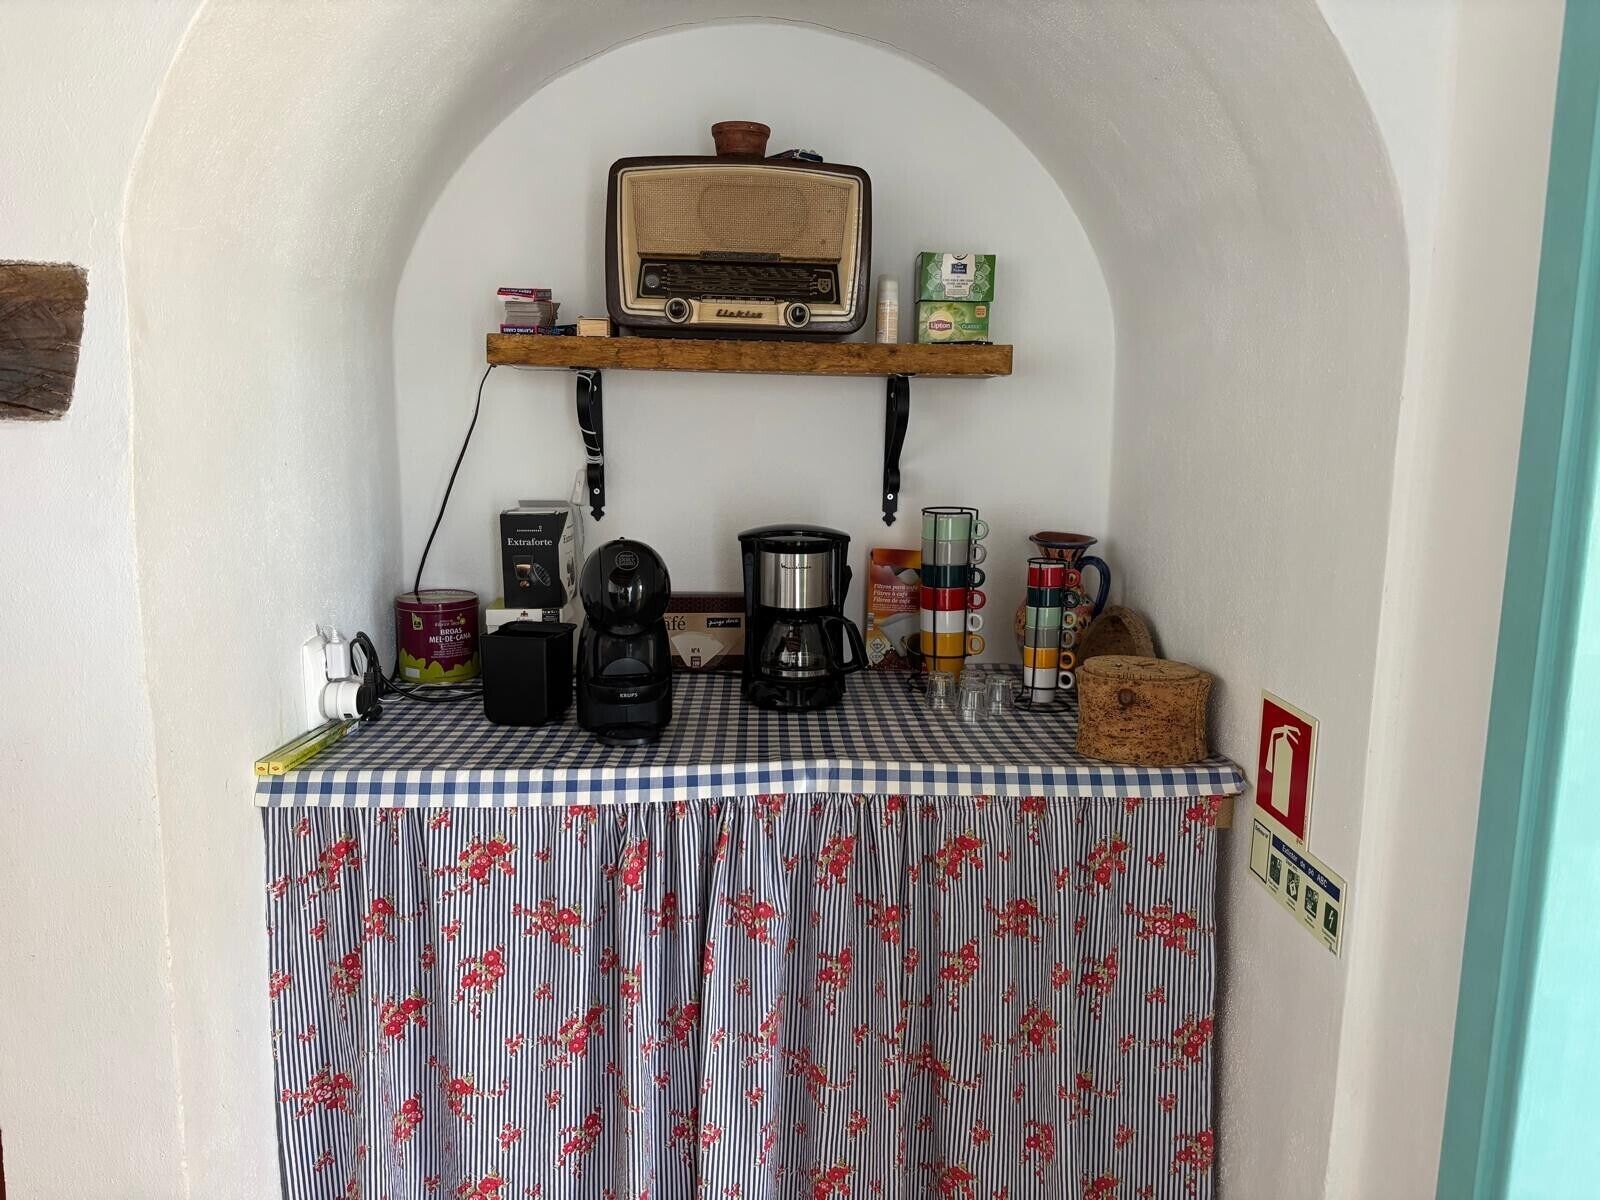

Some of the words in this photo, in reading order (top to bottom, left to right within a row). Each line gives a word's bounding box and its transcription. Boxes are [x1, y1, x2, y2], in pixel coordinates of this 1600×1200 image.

[930, 321, 951, 330] Lipton
[507, 537, 553, 546] Extraforte
[663, 615, 686, 631] afé
[440, 627, 463, 636] BROAS
[1299, 860, 1306, 869] de
[1316, 874, 1328, 888] ABC
